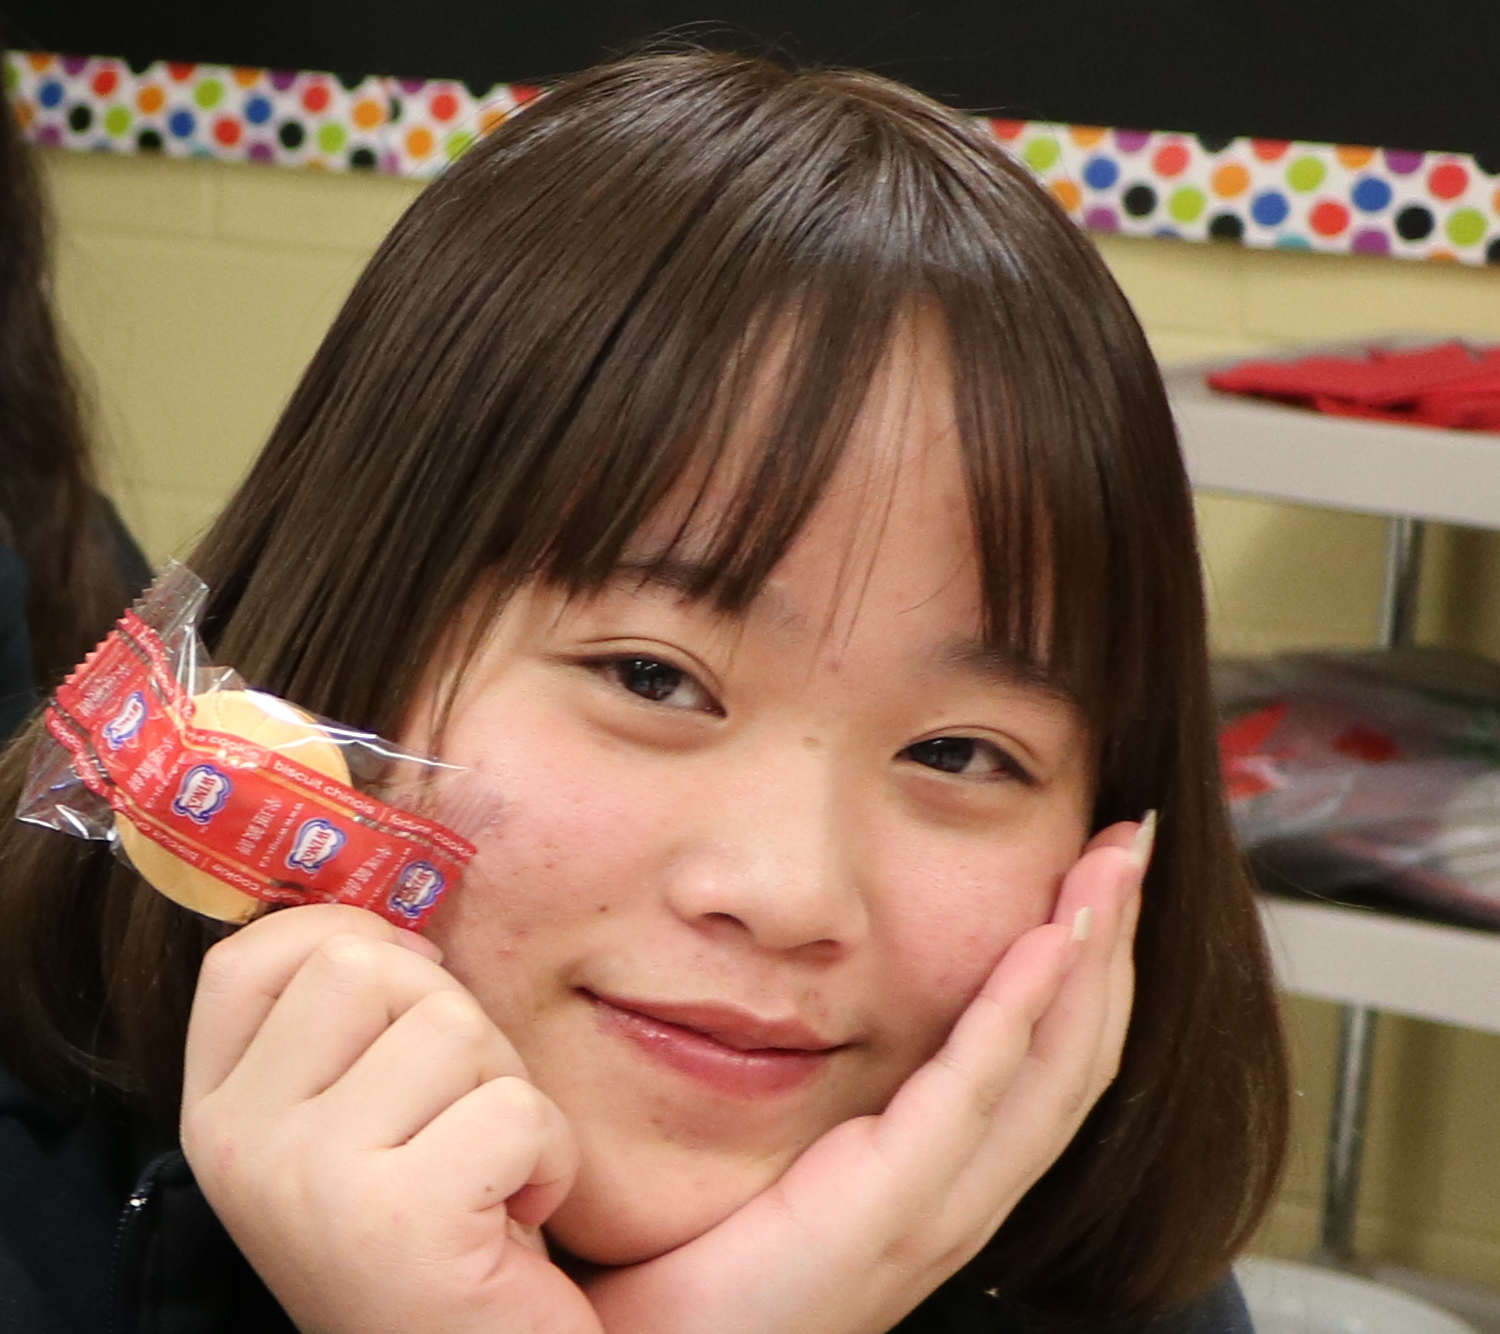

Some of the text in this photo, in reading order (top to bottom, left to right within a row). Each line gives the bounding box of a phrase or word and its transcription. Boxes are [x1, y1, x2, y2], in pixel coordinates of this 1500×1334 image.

[273, 759, 376, 816] biscuit chinois
[433, 832, 474, 858] cooki
[211, 863, 261, 892] cookie
